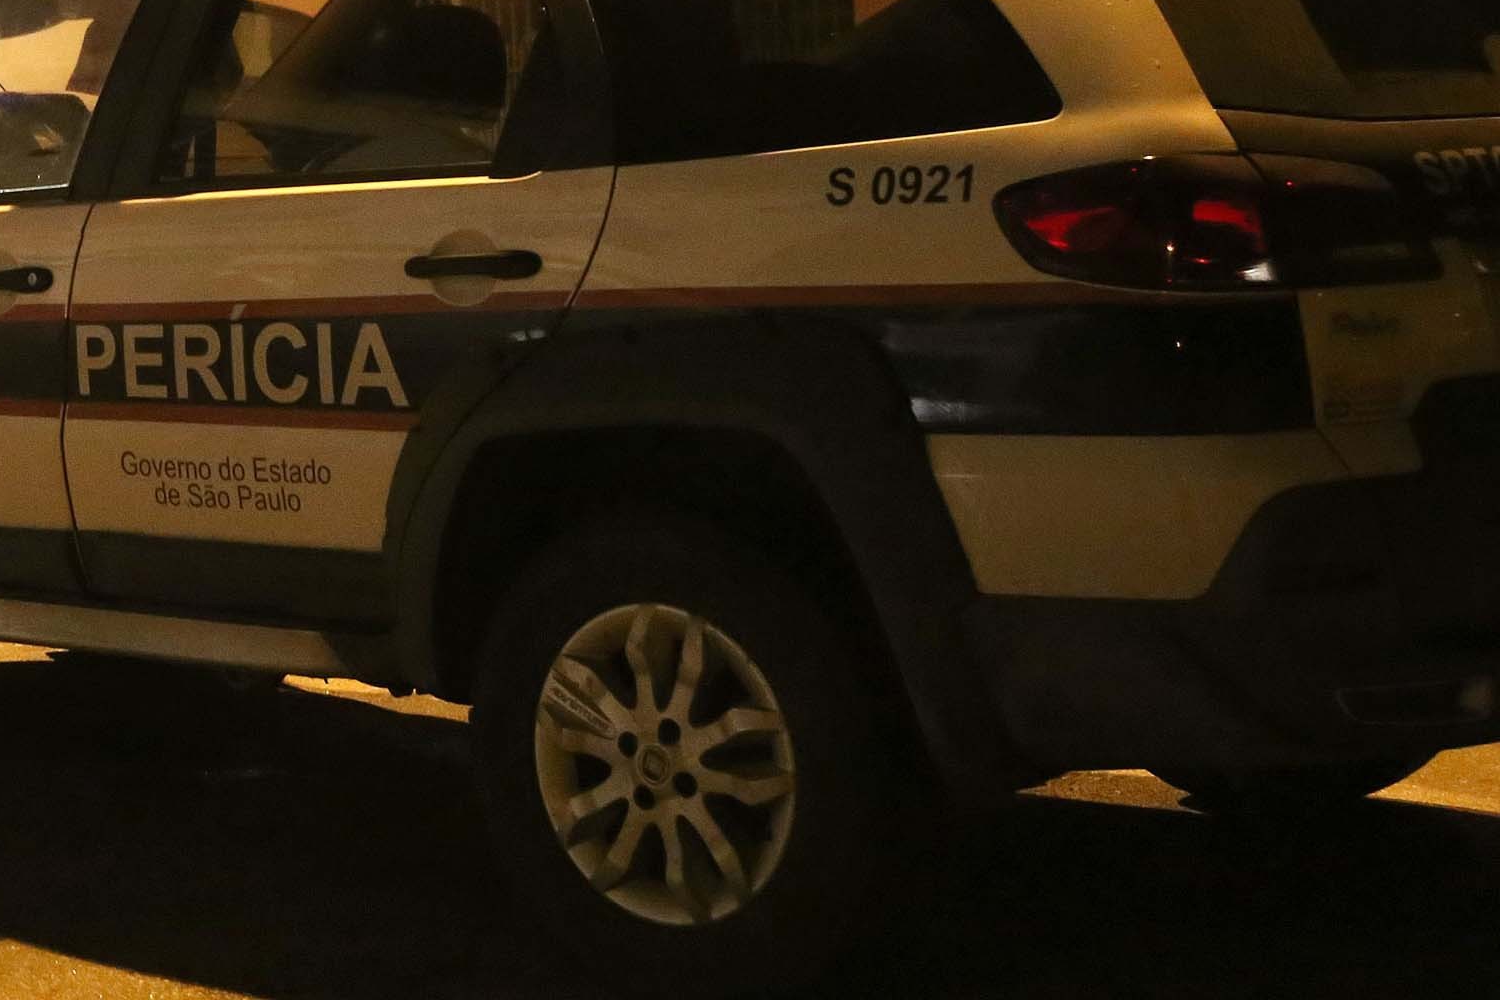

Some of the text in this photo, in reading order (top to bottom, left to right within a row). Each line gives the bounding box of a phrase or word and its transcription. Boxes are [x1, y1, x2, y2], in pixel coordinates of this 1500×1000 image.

[826, 163, 974, 206] S 0921
[75, 303, 411, 408] PERÍCIA
[120, 450, 332, 486] Governo do Estado
[154, 481, 302, 512] de São Paulo
